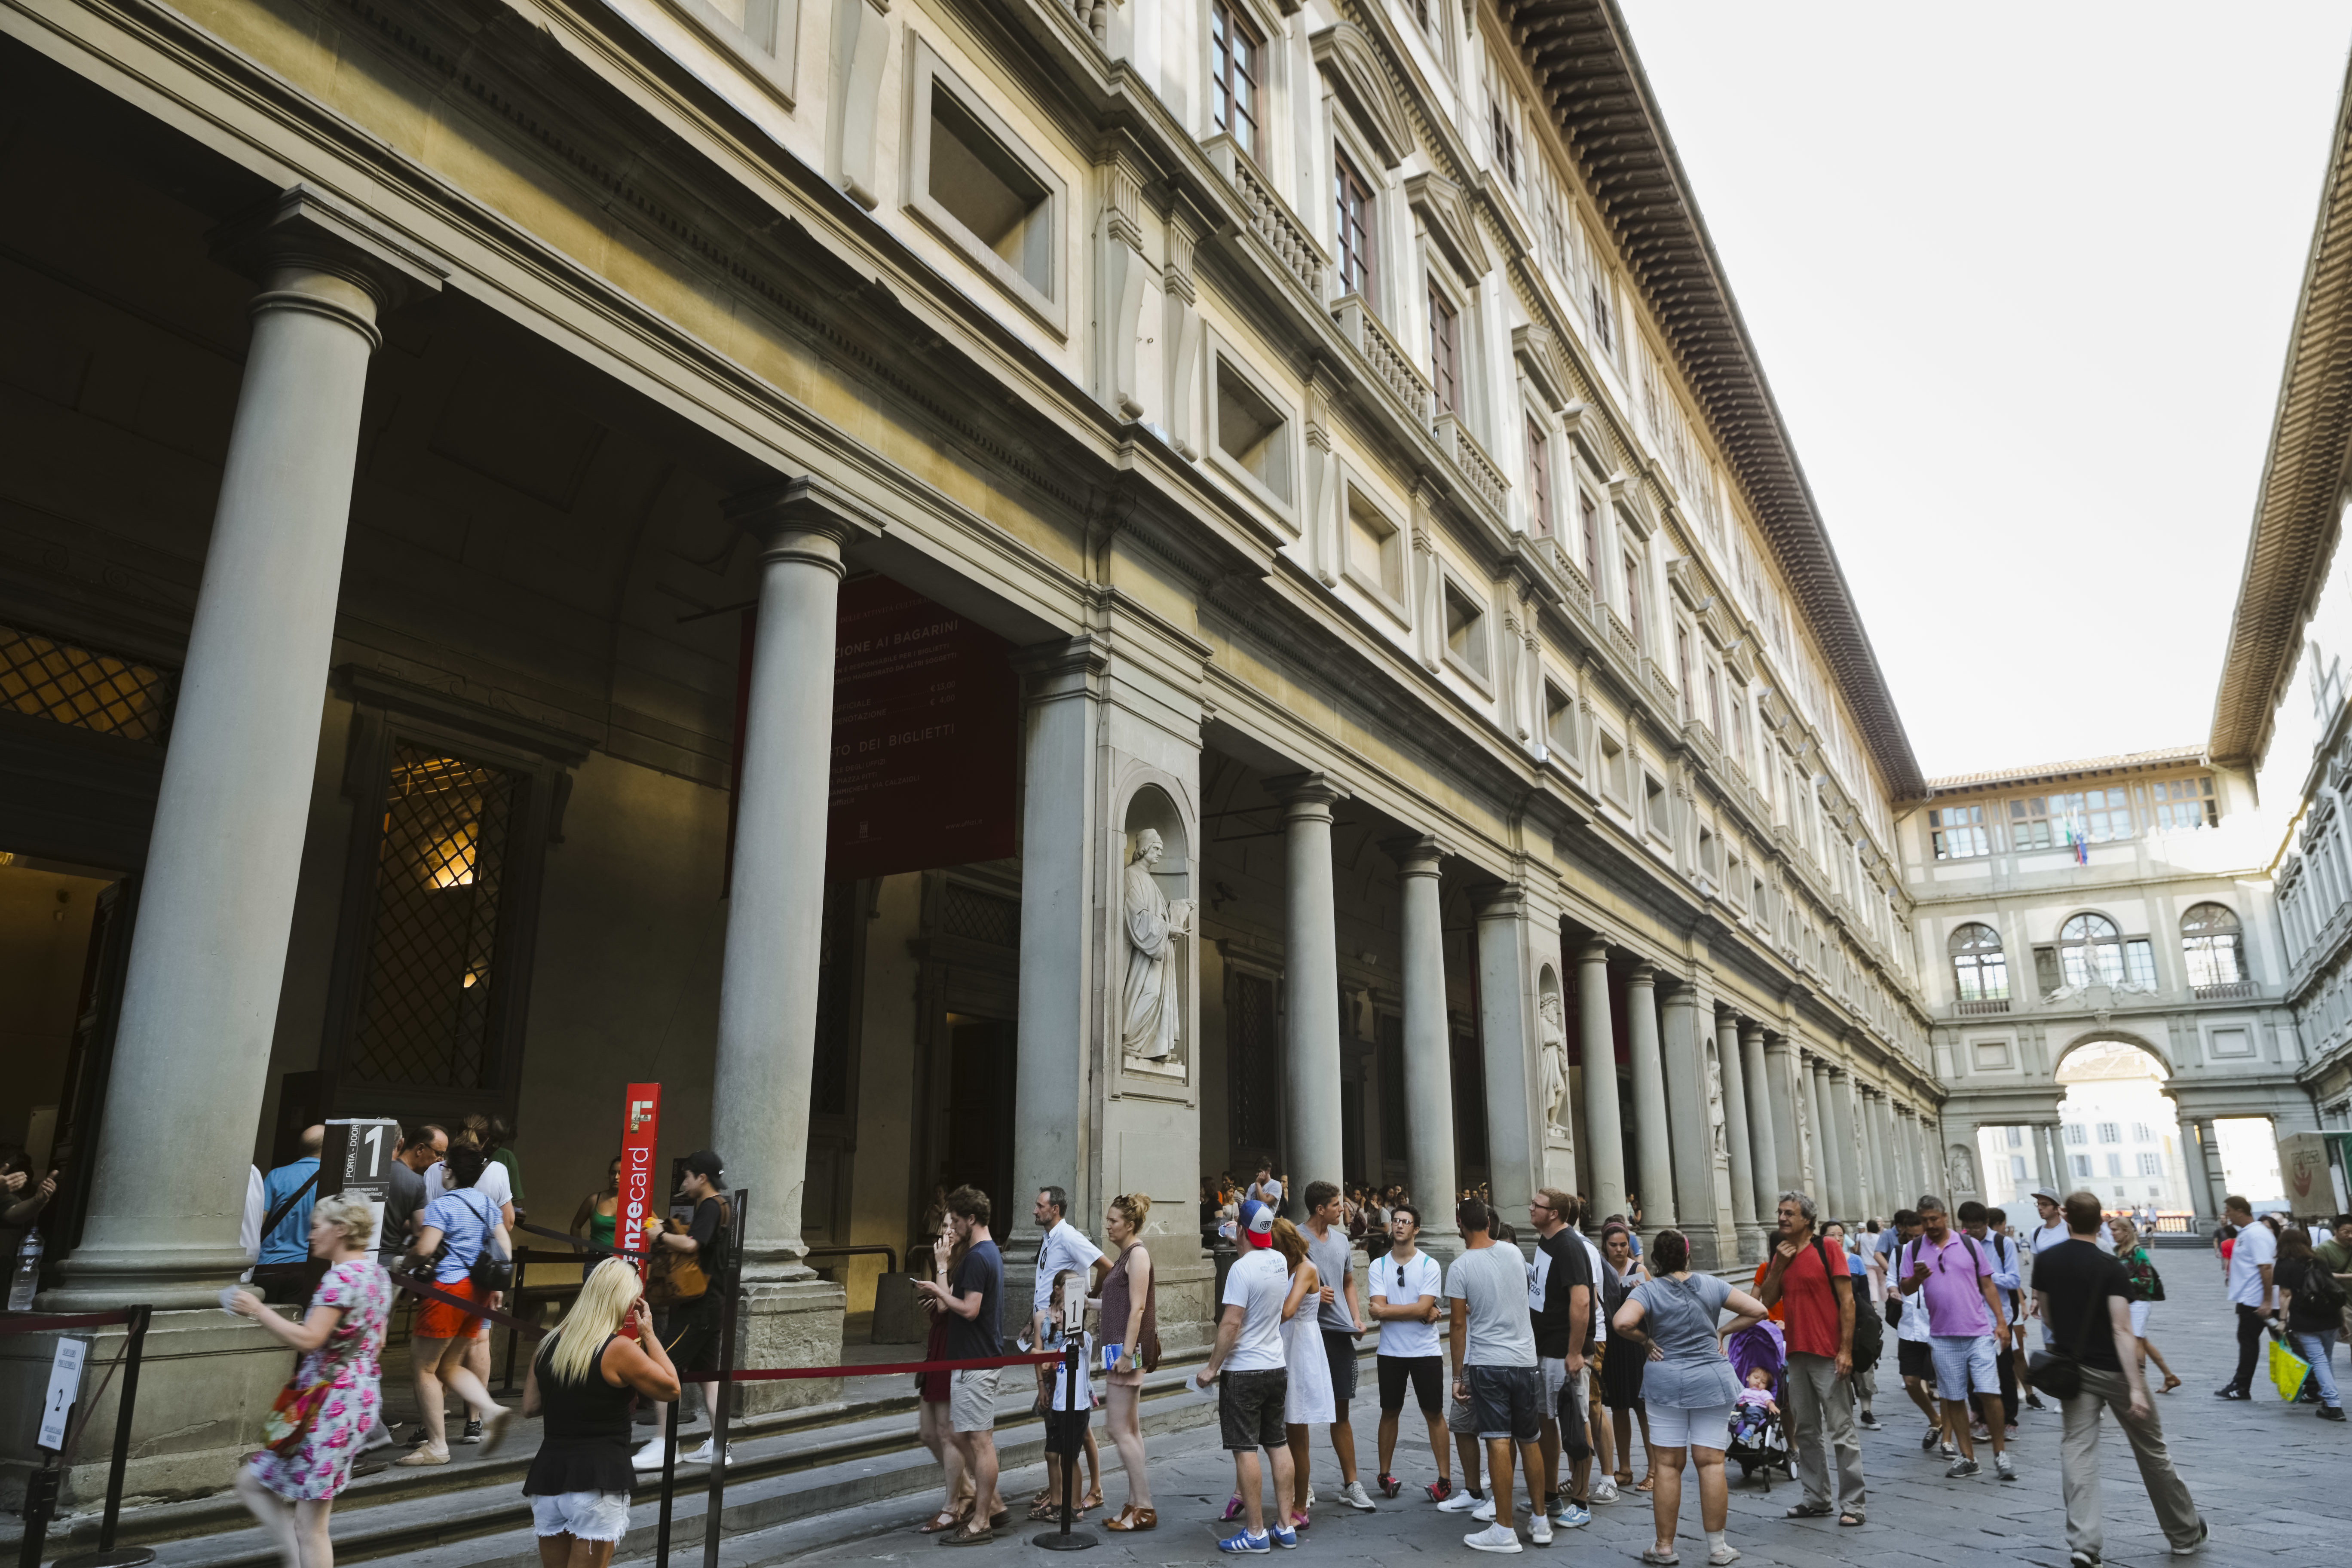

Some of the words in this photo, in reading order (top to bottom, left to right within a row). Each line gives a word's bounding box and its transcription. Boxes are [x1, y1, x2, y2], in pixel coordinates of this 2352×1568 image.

[876, 637, 888, 649] AI
[894, 619, 959, 645] BAGARINI
[834, 676, 851, 685] OSTO
[852, 667, 894, 681] MAGGIORATO
[906, 659, 924, 669] ALTRI
[925, 652, 957, 665] SOGGETTI
[849, 655, 897, 671] RESPONSABILE
[899, 652, 912, 660] PER
[918, 643, 949, 656] BIGLIETTI
[833, 698, 871, 713] UFFICIALE
[936, 680, 956, 691] 13,00
[939, 694, 956, 704] 4,00
[859, 738, 880, 753] DEI
[888, 723, 955, 746] BIGLIETTI
[845, 763, 864, 772] DEGLI
[866, 758, 886, 768] UFFIZI
[836, 776, 860, 784] PIAZZA
[862, 772, 877, 780] PITTI
[885, 775, 920, 787] CALZAIOLI
[946, 819, 982, 830] www.uffizi.it
[349, 1124, 360, 1147] DOOR
[364, 1125, 383, 1177] 1
[345, 1153, 356, 1178] PORTA
[1260, 1221, 1272, 1230] DEUS
[1071, 1299, 1077, 1323] 1
[55, 1388, 63, 1412] 2
